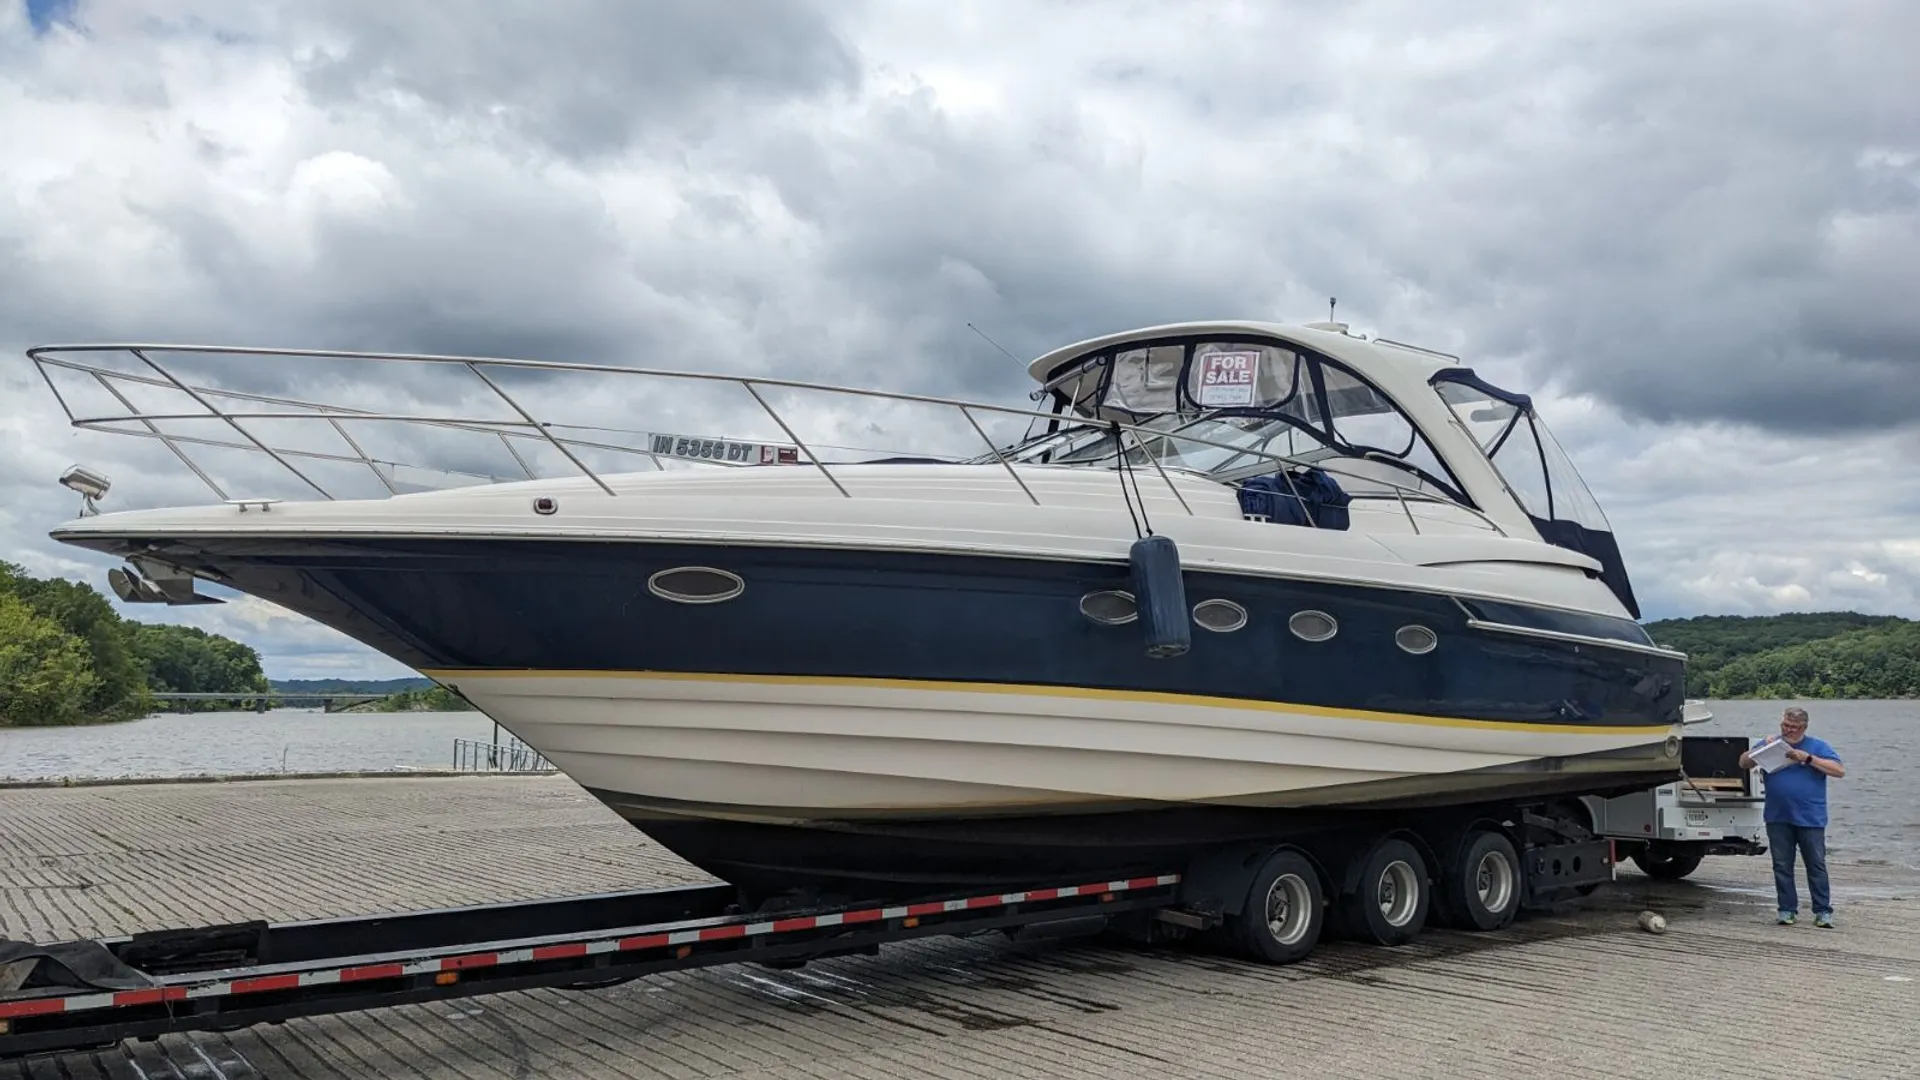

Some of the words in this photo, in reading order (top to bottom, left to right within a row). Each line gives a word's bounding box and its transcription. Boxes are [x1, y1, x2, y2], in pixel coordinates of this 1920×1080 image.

[1211, 356, 1247, 370] FOR
[1205, 370, 1250, 384] SALE
[653, 435, 673, 454] IN
[728, 443, 752, 462] DT
